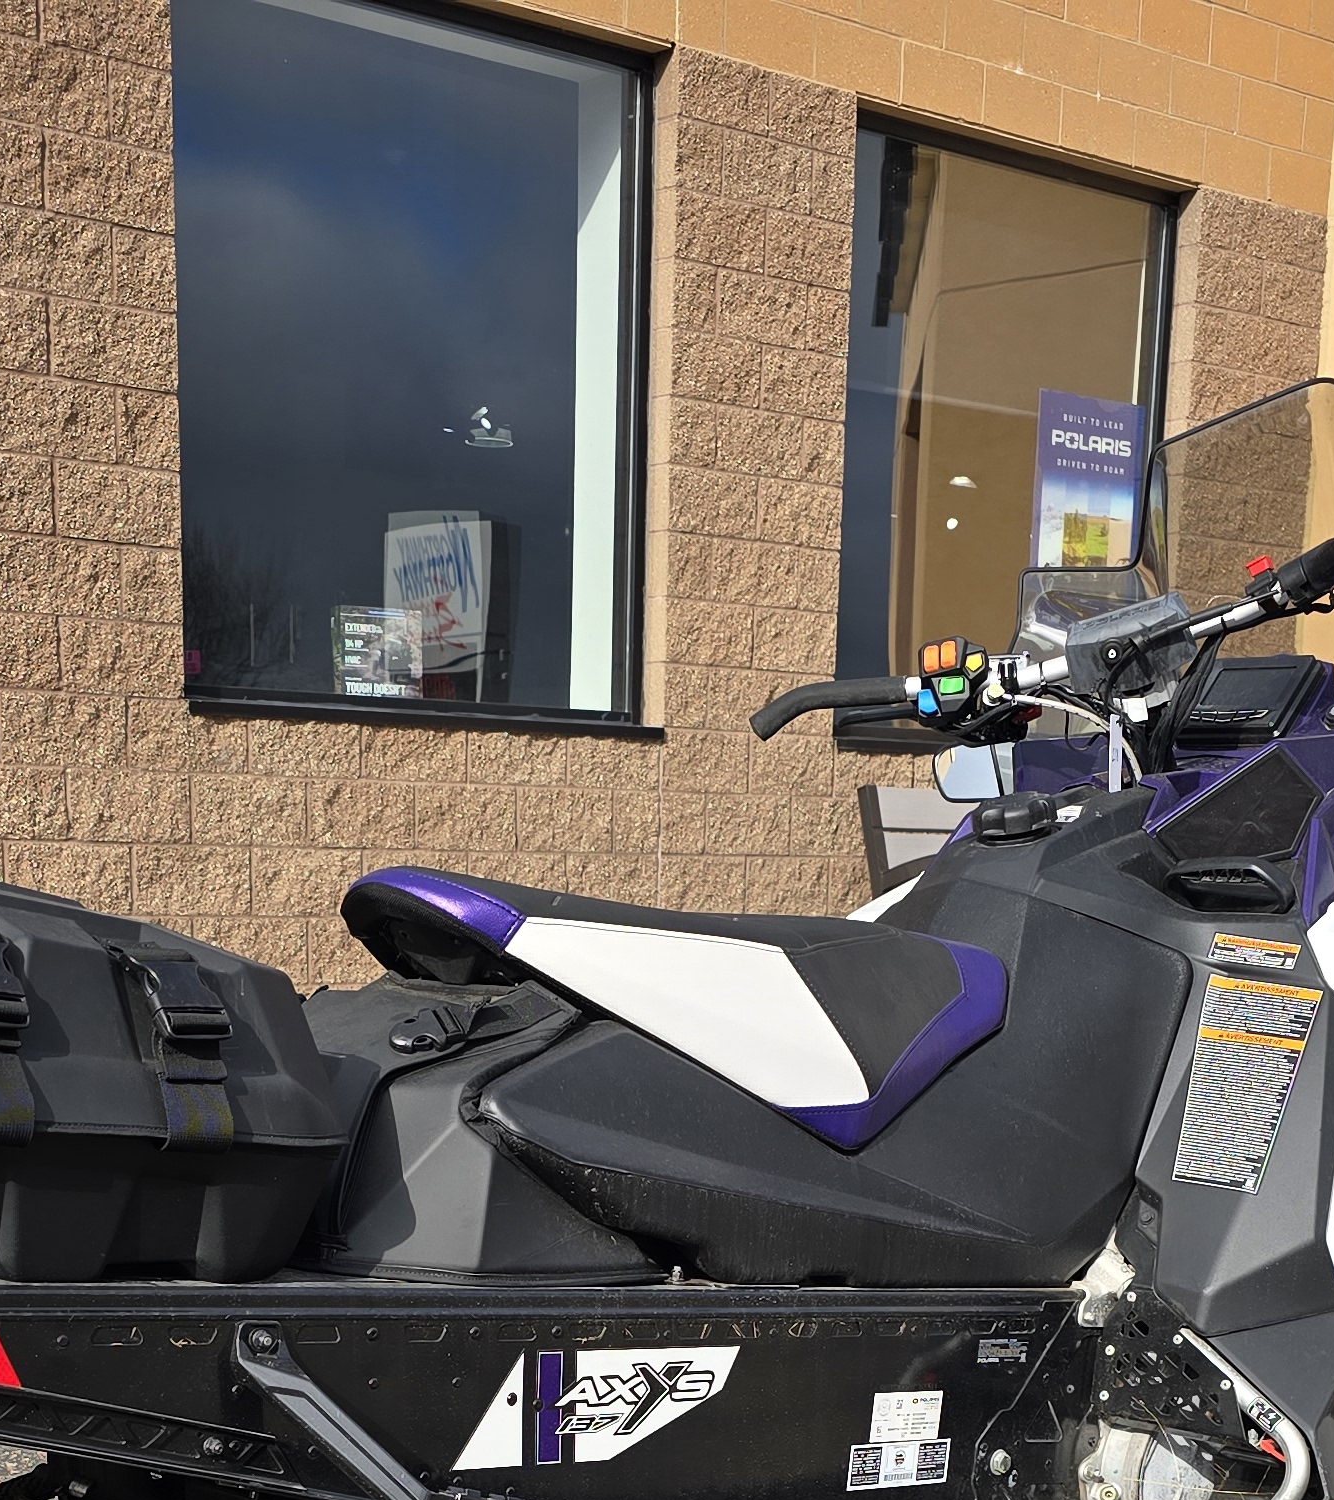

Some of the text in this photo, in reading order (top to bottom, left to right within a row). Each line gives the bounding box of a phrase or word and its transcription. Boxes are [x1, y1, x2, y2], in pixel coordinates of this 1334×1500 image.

[1063, 413, 1124, 431] BUILT TO LEAD
[1051, 428, 1132, 458] POLARIS
[1056, 458, 1125, 475] DRIVEN TO ROAM
[345, 681, 373, 693] TOUGH
[1242, 983, 1301, 997] AVERTISSEMENT
[1225, 1032, 1283, 1046] AVERTISSEMENT
[554, 1360, 716, 1436] AXYS
[554, 1413, 625, 1435] 137
